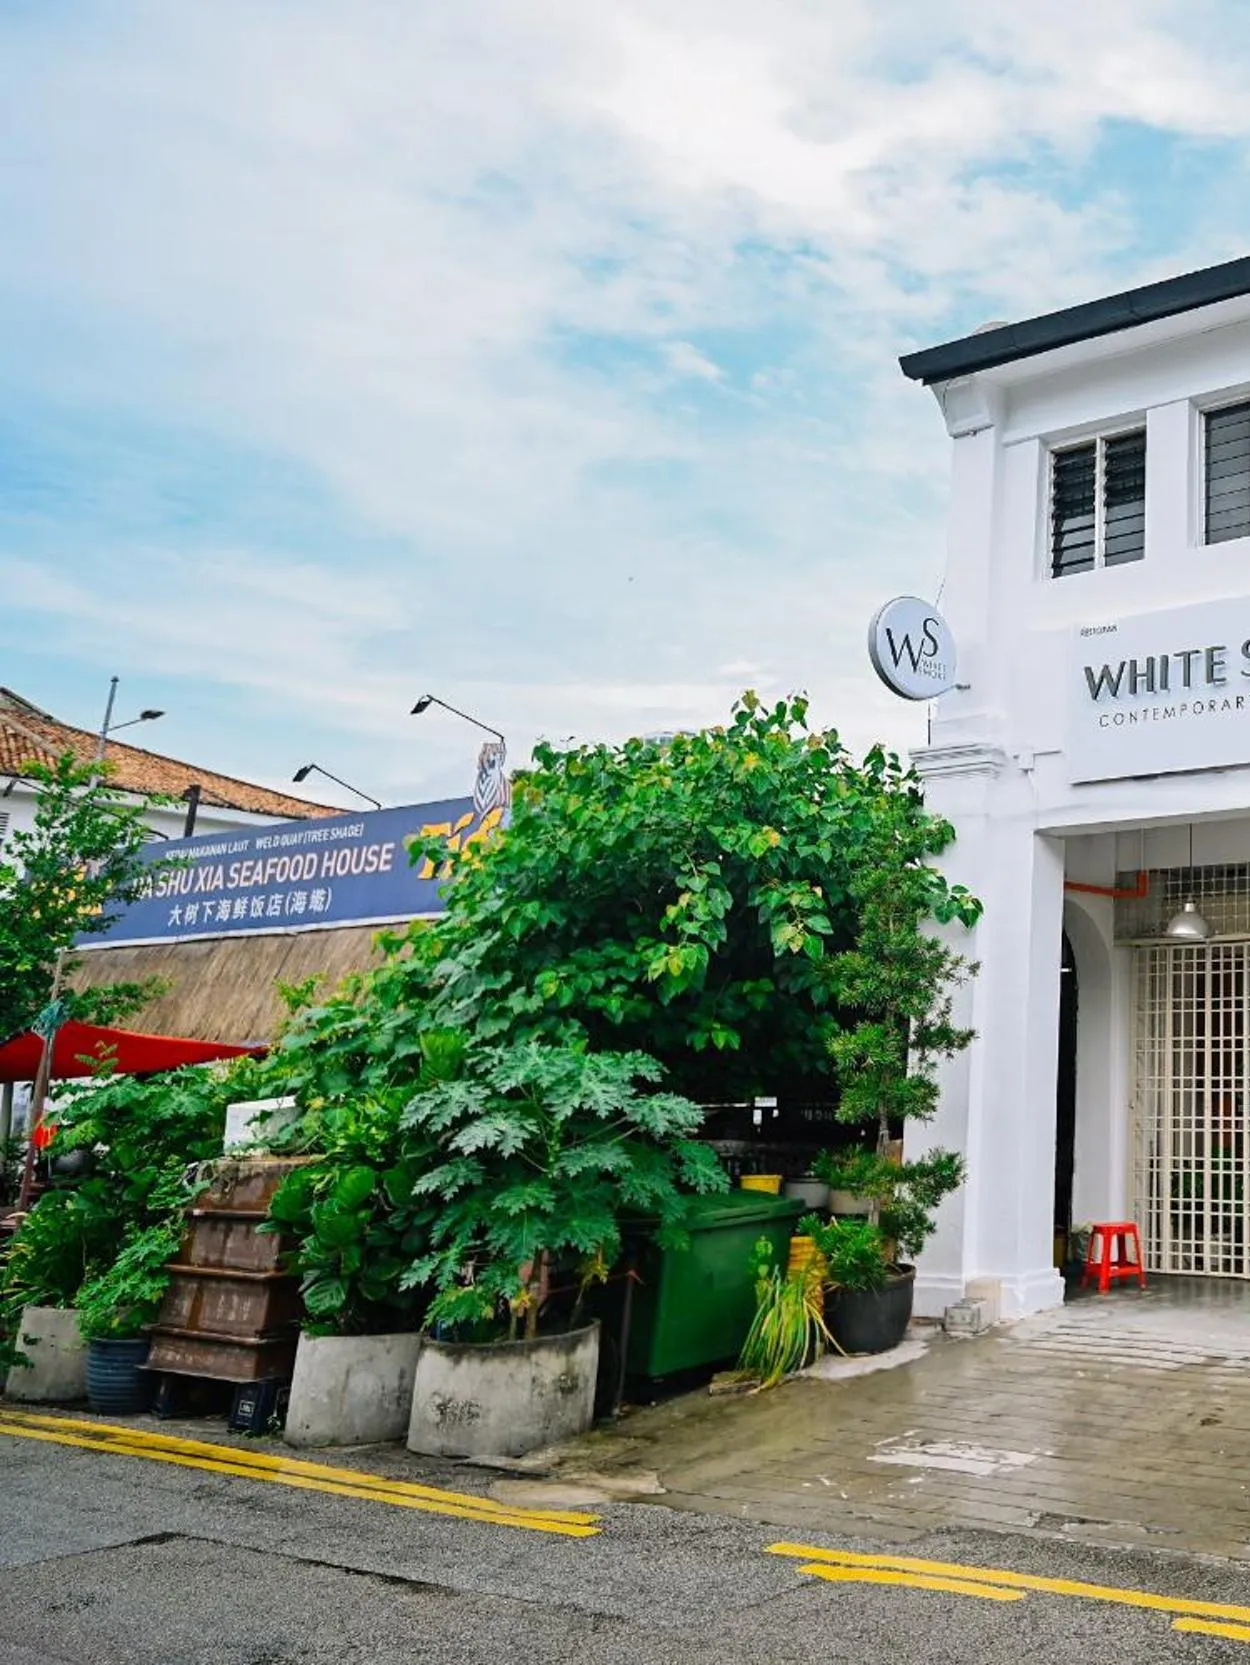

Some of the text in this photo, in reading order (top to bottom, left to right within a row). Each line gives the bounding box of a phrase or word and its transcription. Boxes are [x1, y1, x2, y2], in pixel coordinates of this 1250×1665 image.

[1084, 646, 1227, 701] WHITE
[155, 867, 195, 898] SHU
[193, 864, 225, 893] XIA
[226, 852, 317, 889] SEAFOOD
[320, 842, 396, 879] HOUSE
